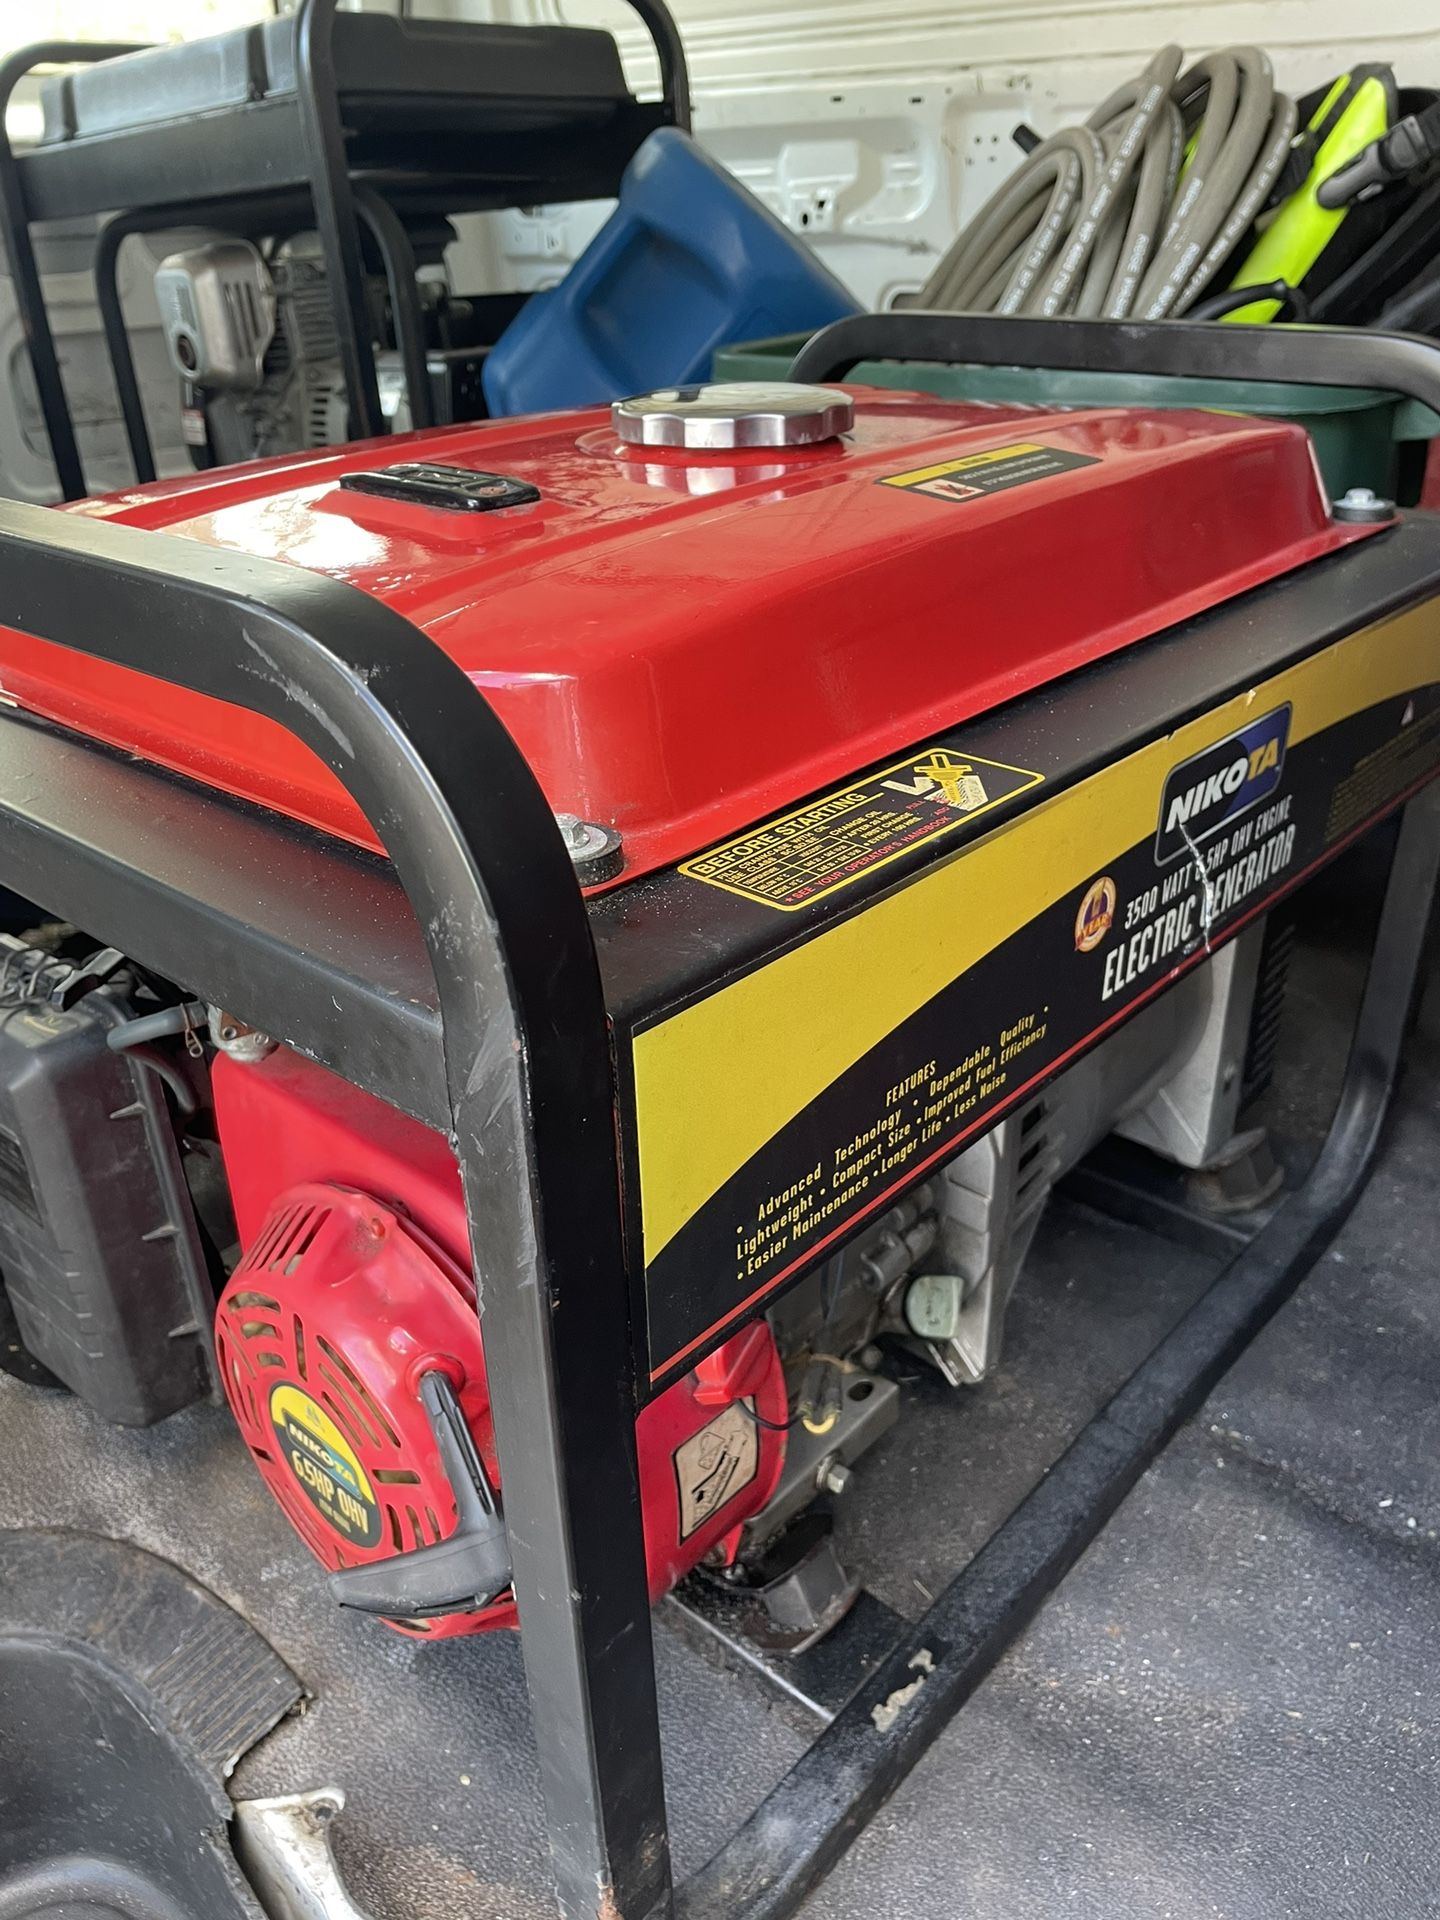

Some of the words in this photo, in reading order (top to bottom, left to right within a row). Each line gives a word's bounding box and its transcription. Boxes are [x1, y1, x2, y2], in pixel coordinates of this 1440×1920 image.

[1165, 738, 1279, 833] NIKOTA
[693, 834, 780, 874] BEFORE
[773, 793, 867, 836] STARTING
[829, 817, 867, 835] CHANGE
[865, 810, 882, 818] OIL
[846, 824, 872, 836] AFTER
[861, 827, 884, 838] FIRST
[882, 813, 913, 828] CHANGE
[868, 831, 893, 843] EVERY
[717, 869, 738, 879] FILL
[738, 843, 791, 869] CRANKCASE
[791, 833, 813, 843] WITH
[726, 873, 745, 882] USE
[747, 858, 776, 872] CLASS
[792, 887, 815, 898] SEE
[816, 872, 845, 885] YOUR
[844, 842, 902, 871] OPERATOR'S
[901, 816, 951, 841] HANDBOOK
[1124, 885, 1159, 930] 3500
[1162, 862, 1193, 905] WATT
[1231, 820, 1254, 856] OHV
[1254, 794, 1293, 840] ENGINE
[1101, 895, 1196, 1001] ELECTRIC
[886, 1060, 936, 1107] FEATURES
[737, 1194, 813, 1260] Lightweight
[832, 1143, 882, 1188] Compact
[888, 1123, 911, 1147] Size
[924, 1075, 971, 1121] Improved
[976, 1057, 996, 1083] Fuel
[1000, 1023, 1047, 1065] Efficiency
[758, 1162, 822, 1221] Advanced
[835, 1109, 901, 1165] Technology
[930, 1045, 990, 1096] Dependable
[1000, 1014, 1035, 1047] Quality
[747, 1236, 788, 1276] Easier
[792, 1175, 869, 1241] Maintenance
[881, 1137, 918, 1173] Longer
[921, 1120, 942, 1143] Life
[954, 1094, 976, 1119] Less
[980, 1072, 1007, 1099] Noise
[289, 1423, 357, 1488] NIKOTA
[337, 1487, 368, 1534] OHV
